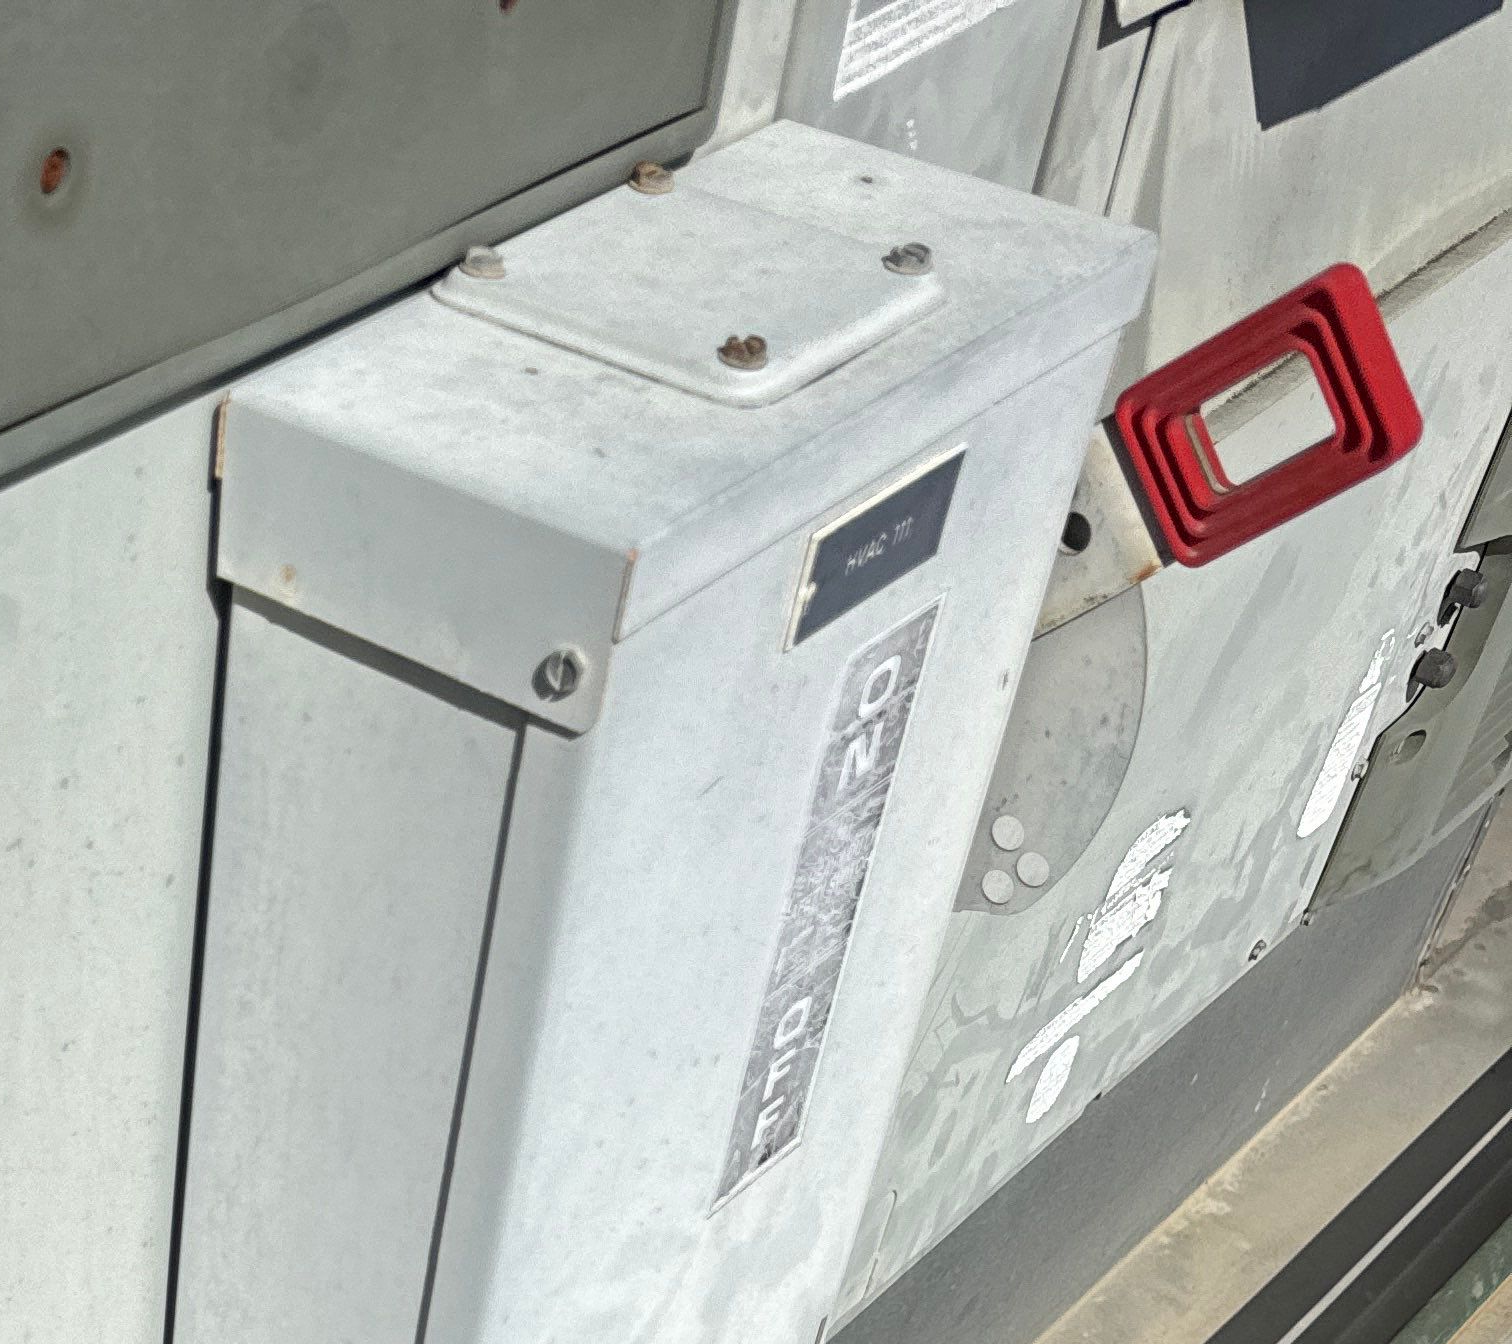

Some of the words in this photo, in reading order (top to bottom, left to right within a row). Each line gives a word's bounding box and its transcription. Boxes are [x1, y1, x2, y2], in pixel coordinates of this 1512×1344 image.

[845, 531, 888, 577] HVAC
[836, 654, 902, 796] ON
[750, 996, 813, 1151] OFF
